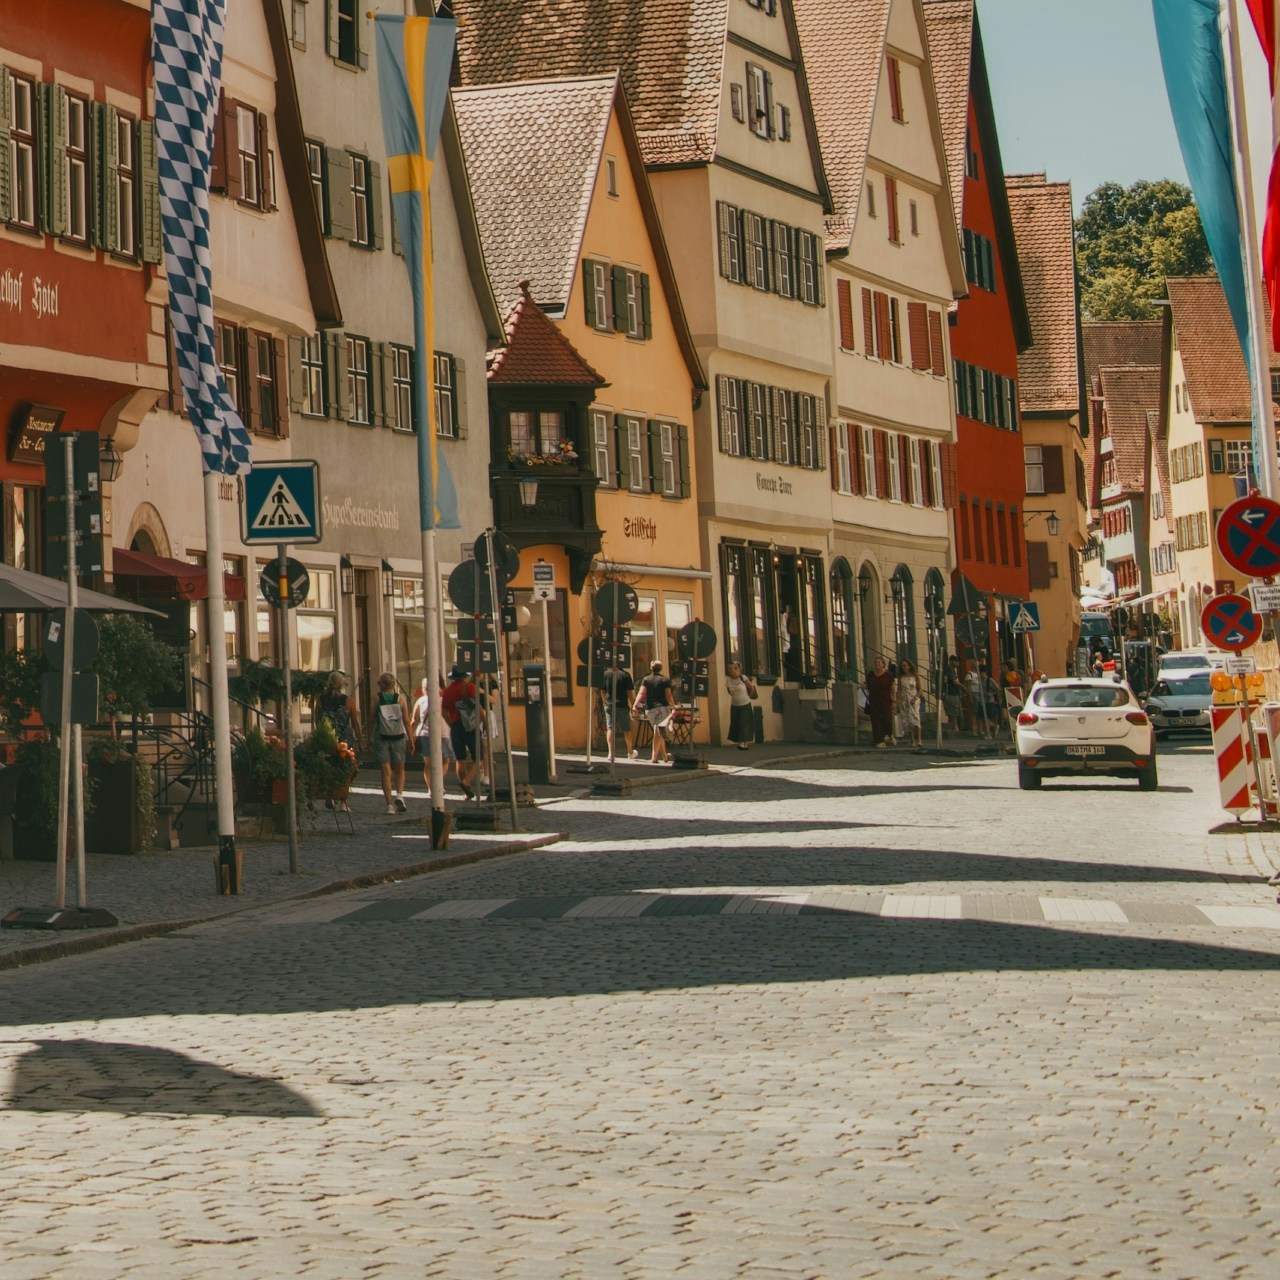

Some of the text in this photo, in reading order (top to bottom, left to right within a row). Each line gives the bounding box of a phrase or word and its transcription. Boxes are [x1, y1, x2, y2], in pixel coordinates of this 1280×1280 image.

[31, 276, 60, 319] Hotel
[218, 476, 233, 502] elier
[322, 495, 400, 530] HypoVereinsbank
